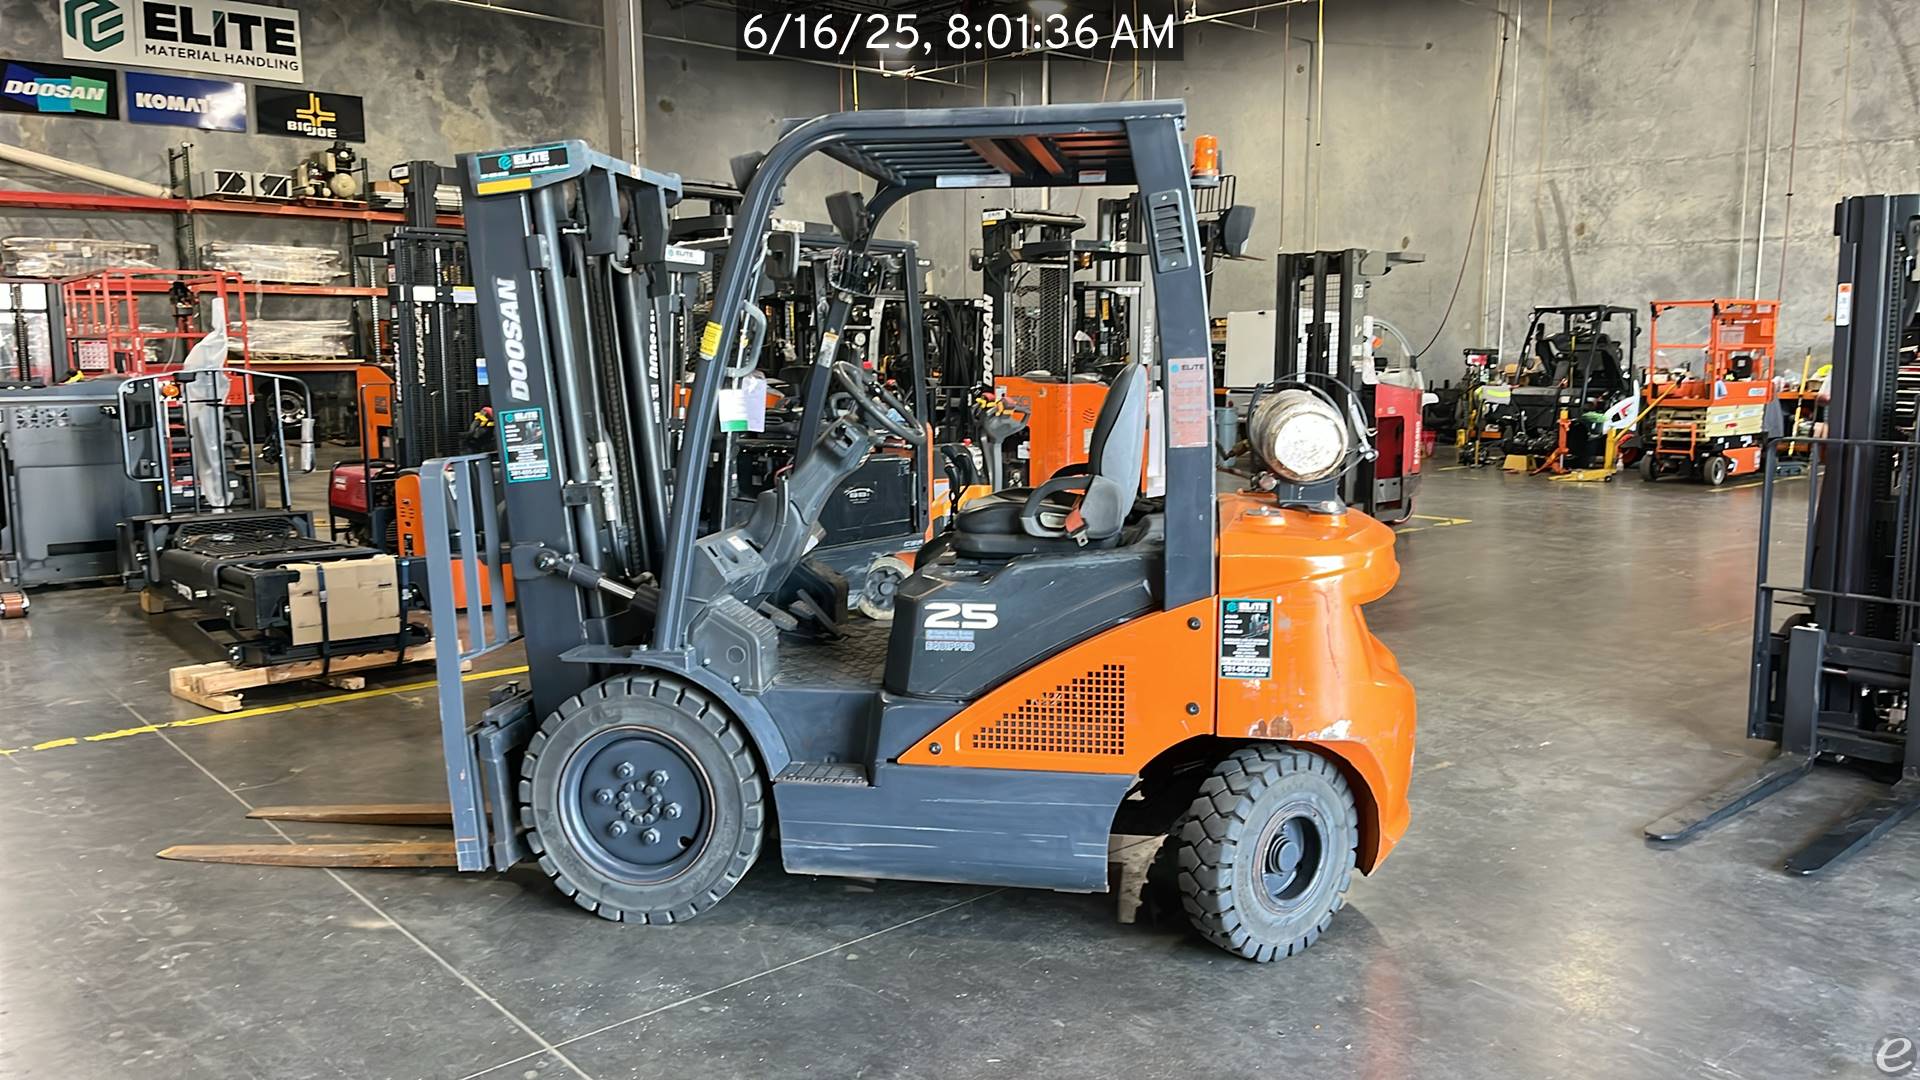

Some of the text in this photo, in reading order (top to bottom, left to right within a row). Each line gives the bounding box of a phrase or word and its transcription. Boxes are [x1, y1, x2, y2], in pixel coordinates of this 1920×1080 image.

[143, 2, 297, 57] ELITE
[145, 44, 299, 72] MATERIAL HANDLING
[4, 79, 105, 101] DOOSAN
[513, 151, 549, 165] ELITE
[497, 278, 530, 401] DOOSAN
[983, 294, 994, 387] DOOSAN
[924, 602, 999, 629] 25
[1238, 602, 1268, 611] ELITE
